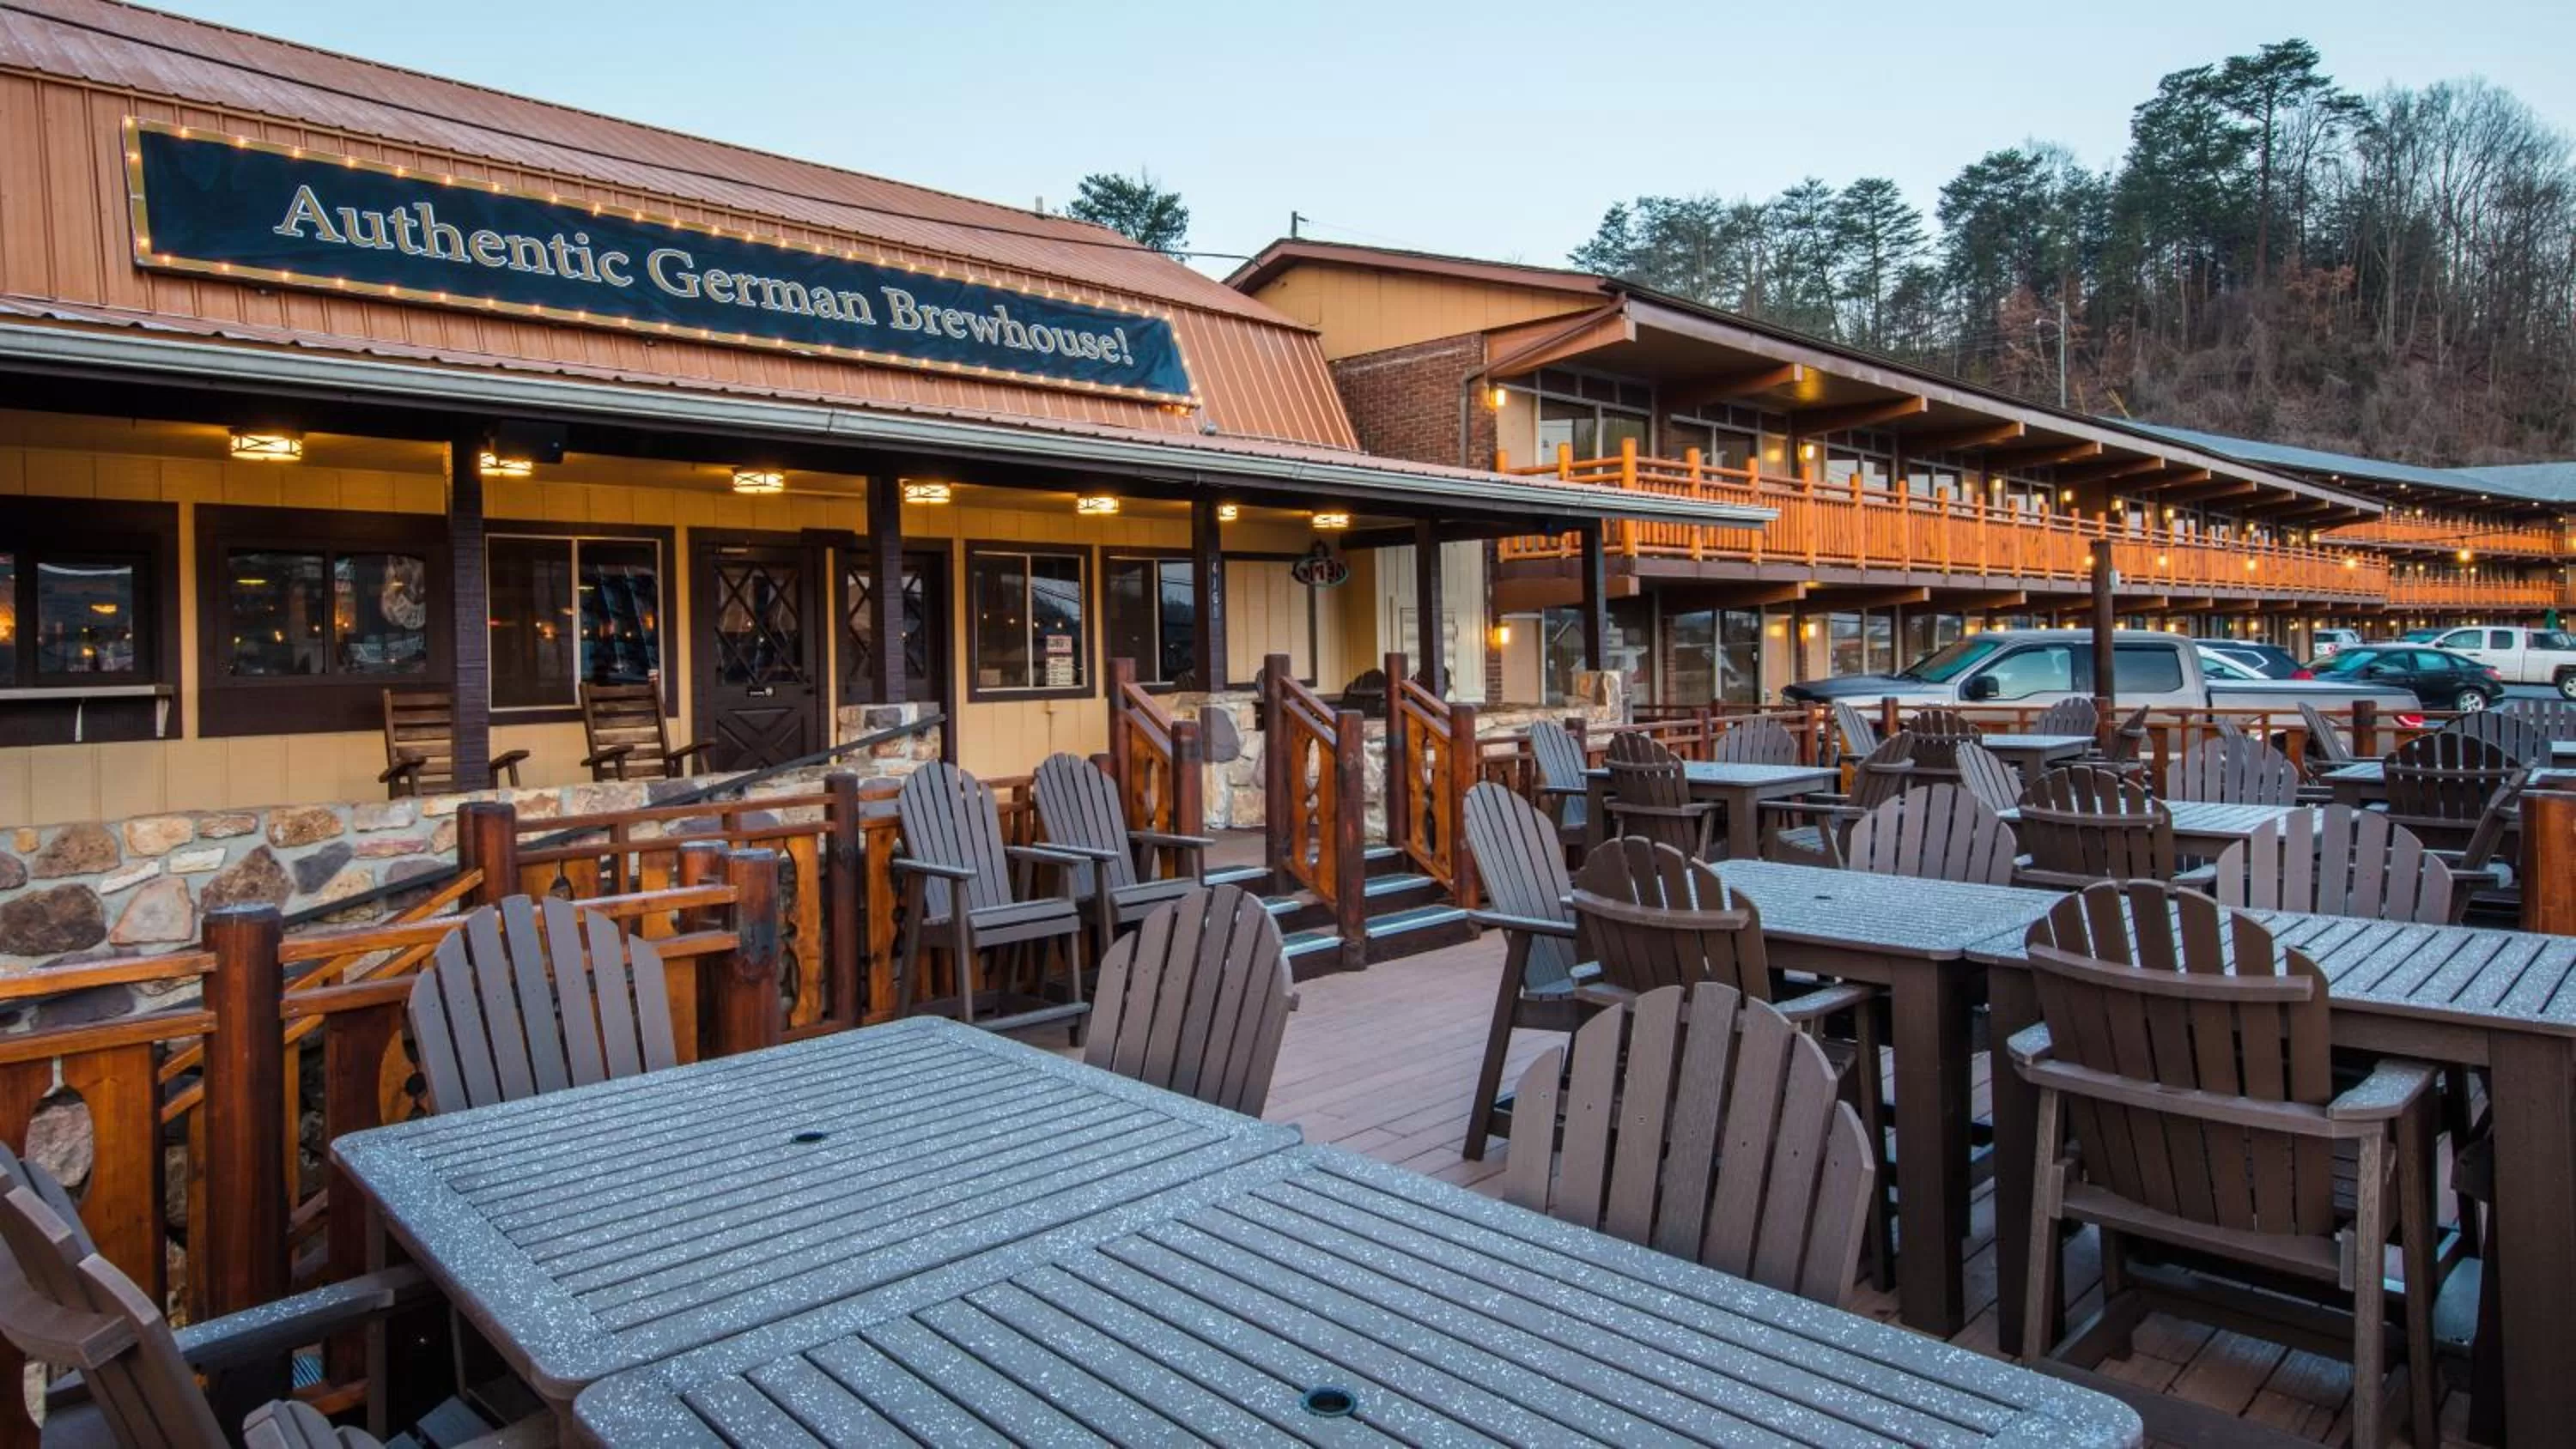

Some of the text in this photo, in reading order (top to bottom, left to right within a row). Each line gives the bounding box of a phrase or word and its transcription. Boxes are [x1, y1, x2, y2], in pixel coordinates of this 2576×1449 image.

[273, 184, 1133, 366] Authentic German Brewhouse!
